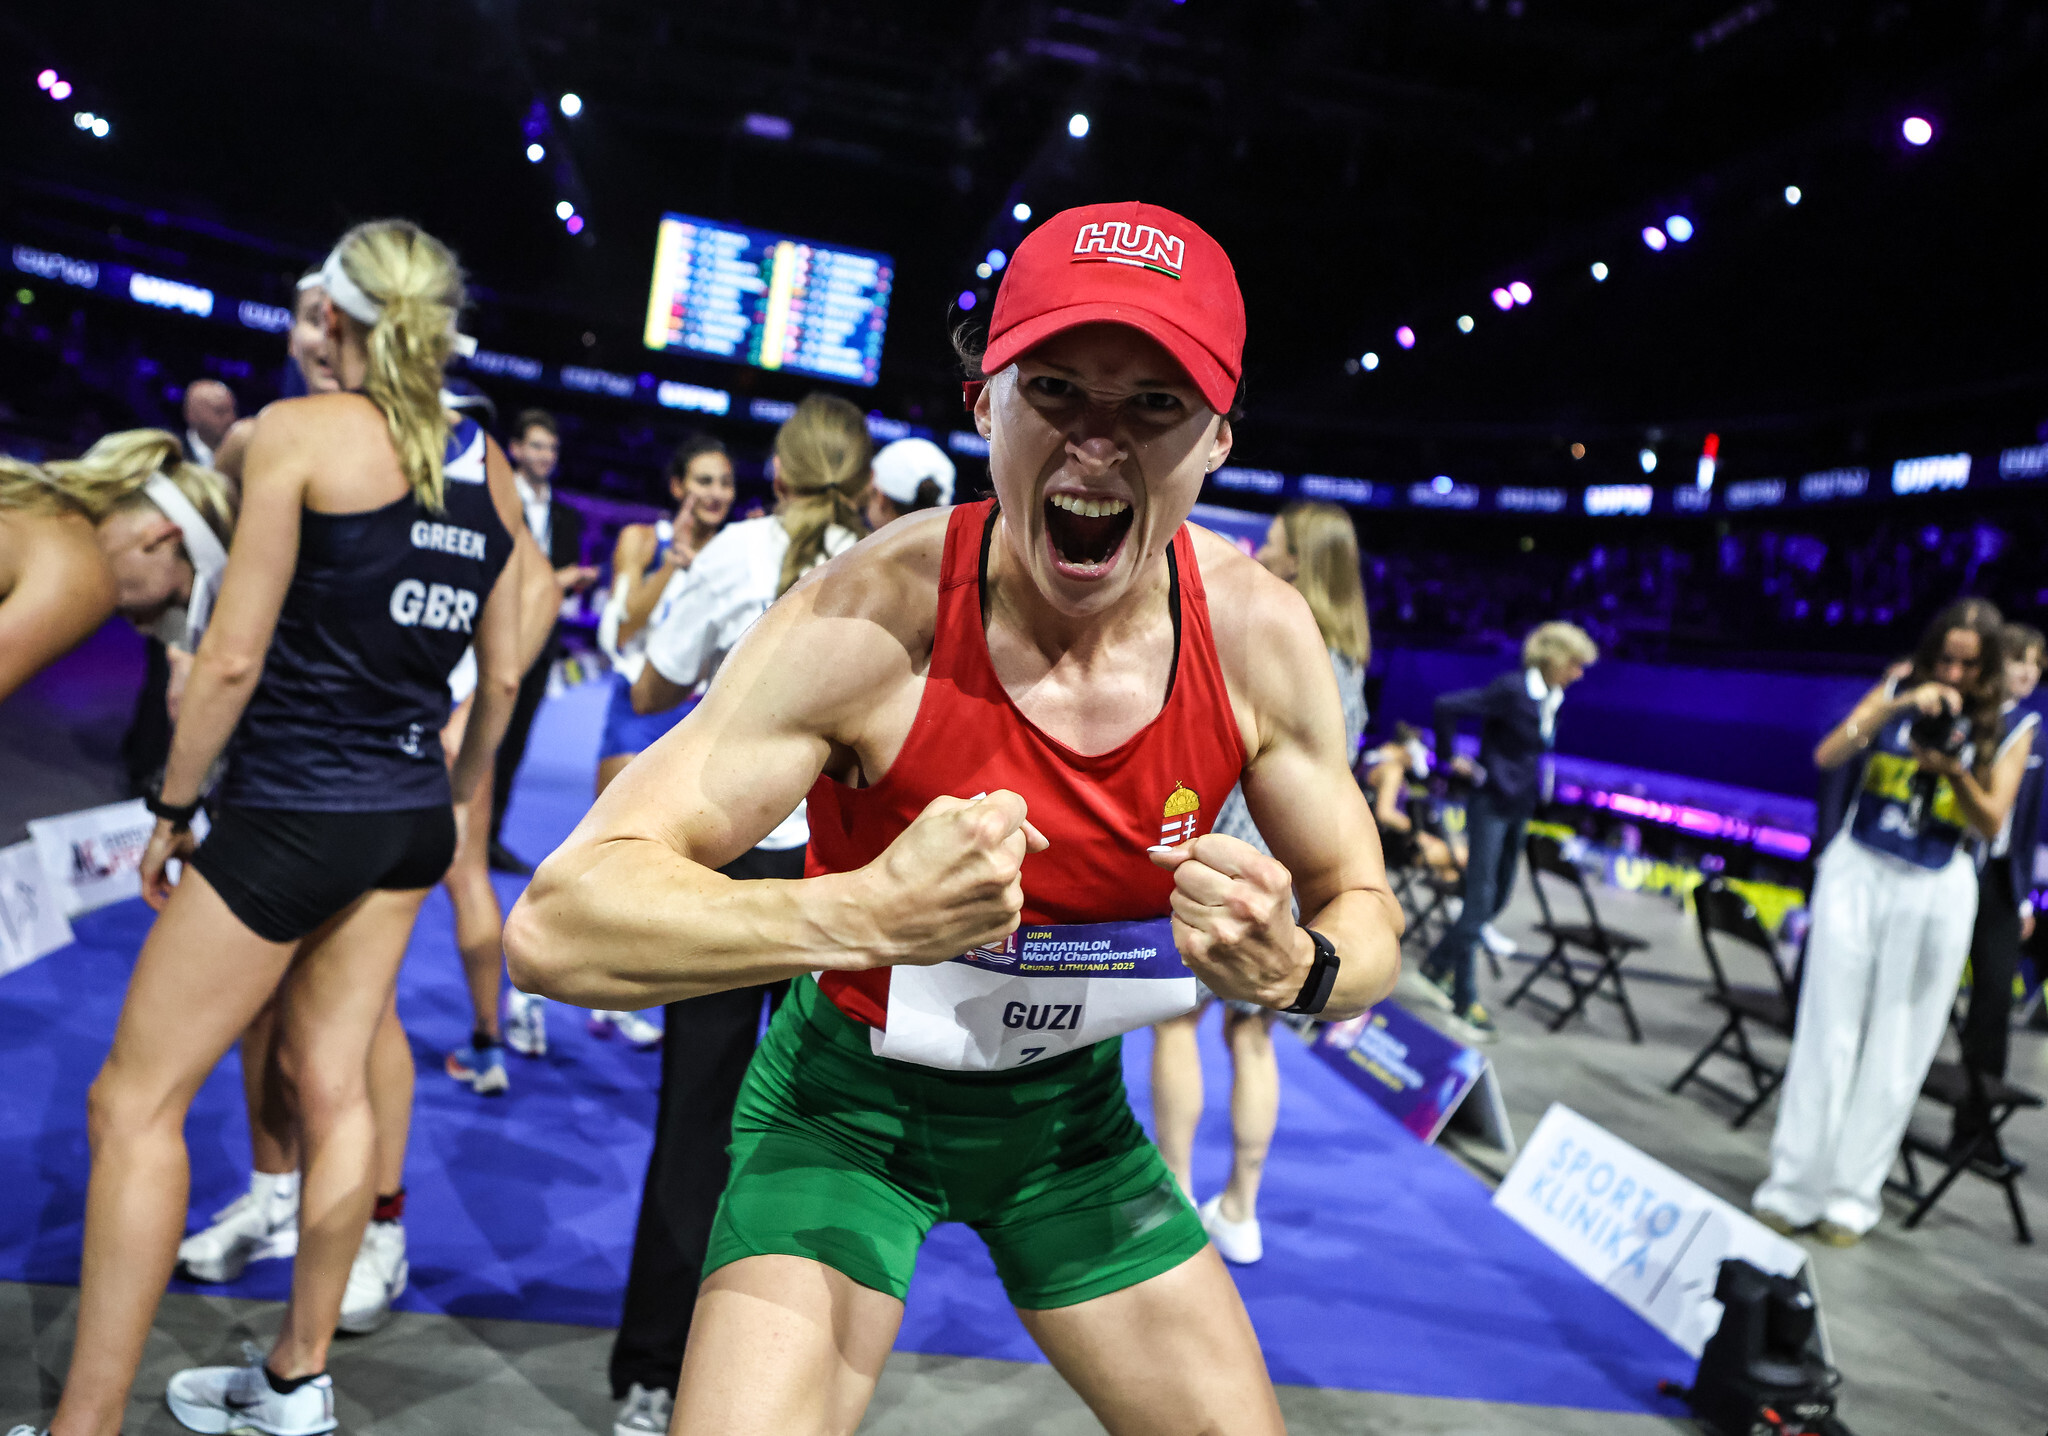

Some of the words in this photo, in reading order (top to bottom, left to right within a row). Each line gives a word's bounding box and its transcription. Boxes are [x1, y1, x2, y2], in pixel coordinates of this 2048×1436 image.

[1074, 222, 1185, 270] HUN
[410, 520, 486, 562] GREEN
[389, 578, 478, 633] GBR
[1023, 940, 1111, 952] PENTATHLON
[1026, 932, 1052, 940] UIPM
[1019, 963, 1057, 972] Kaunas,
[1059, 963, 1110, 971] LITHUANIA
[1111, 962, 1135, 970] 2025
[1022, 951, 1061, 962] World
[1064, 947, 1157, 962] Championships
[1002, 1001, 1083, 1030] GUZI
[1550, 1138, 1682, 1239] SPORTO
[1528, 1169, 1650, 1279] KLINIKA
